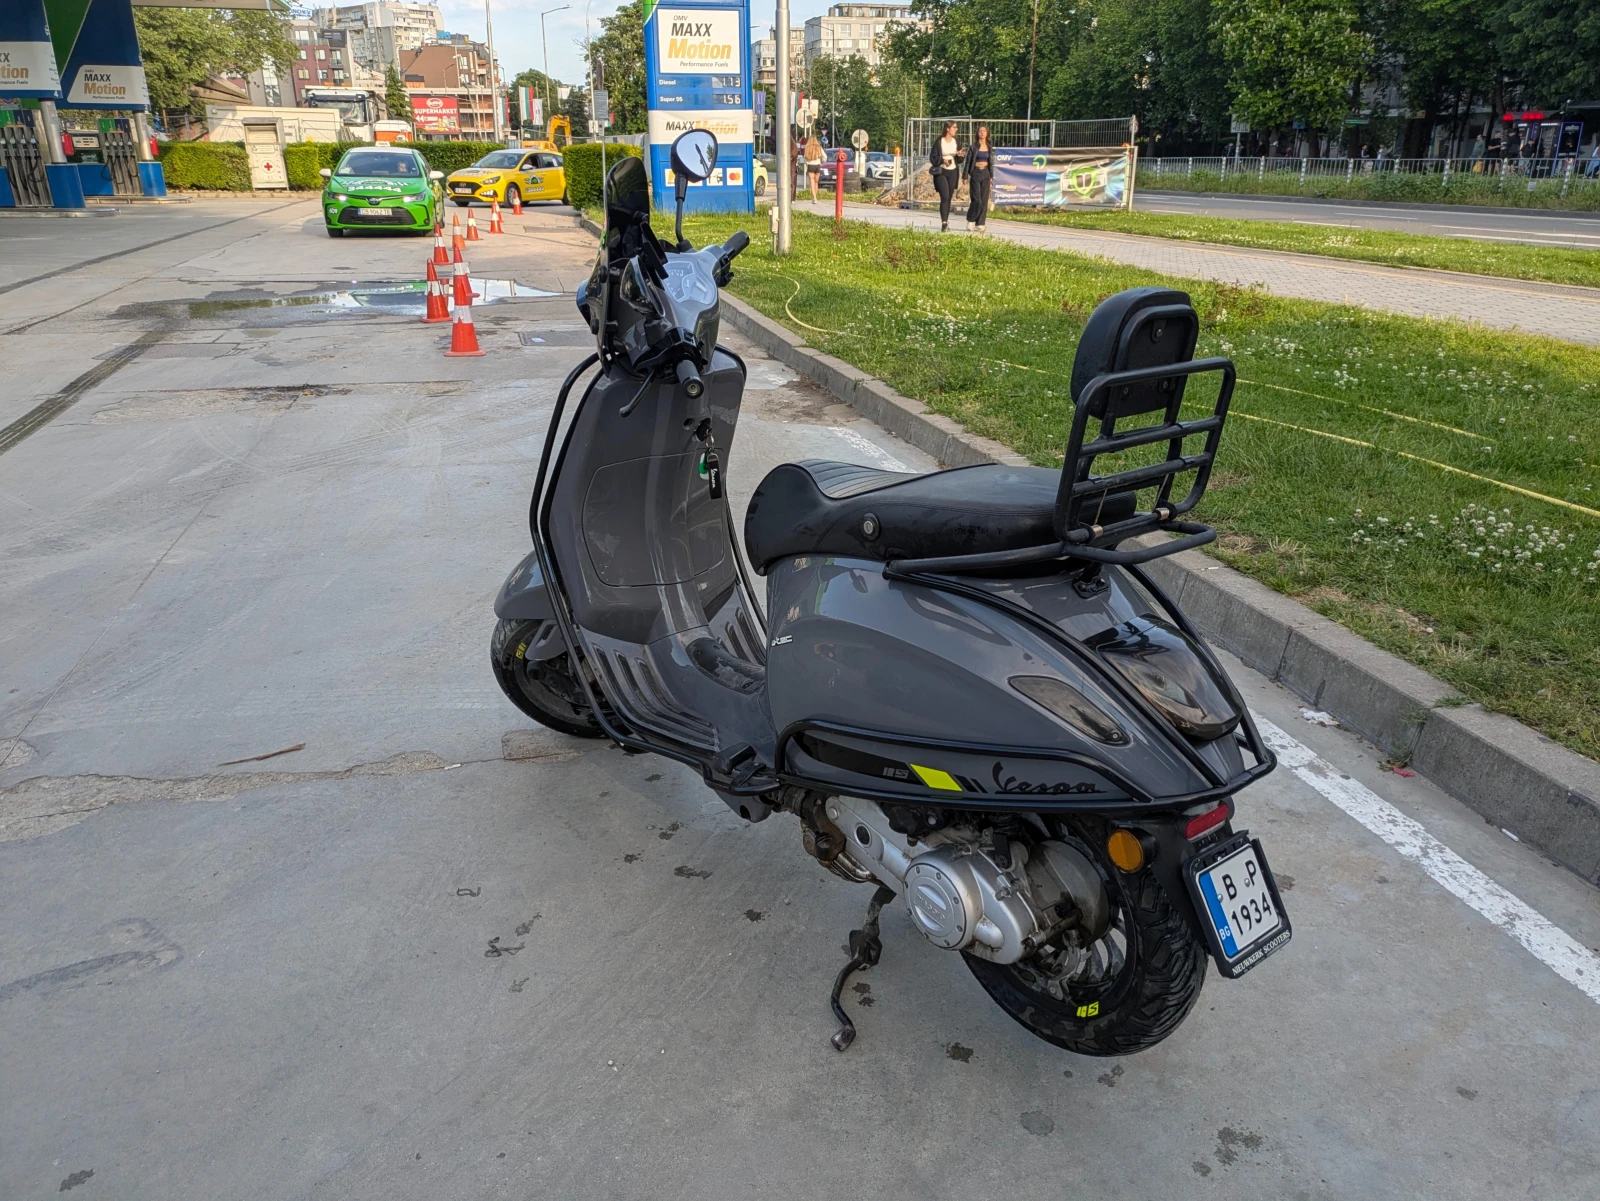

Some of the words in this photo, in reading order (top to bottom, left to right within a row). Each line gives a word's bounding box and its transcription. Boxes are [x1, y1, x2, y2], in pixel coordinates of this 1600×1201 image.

[671, 22, 713, 37] MAXX
[668, 38, 732, 60] Motion
[0, 64, 29, 79] tion
[84, 73, 112, 83] MAXX
[83, 82, 126, 96] Motion
[992, 760, 1108, 796] Vespa
[1221, 873, 1238, 901] B
[1244, 859, 1258, 887] P
[1231, 891, 1273, 936] 1934
[1219, 925, 1232, 941] BG
[1232, 950, 1265, 977] NIEUWKERK
[1263, 929, 1292, 955] SCOOTERS
